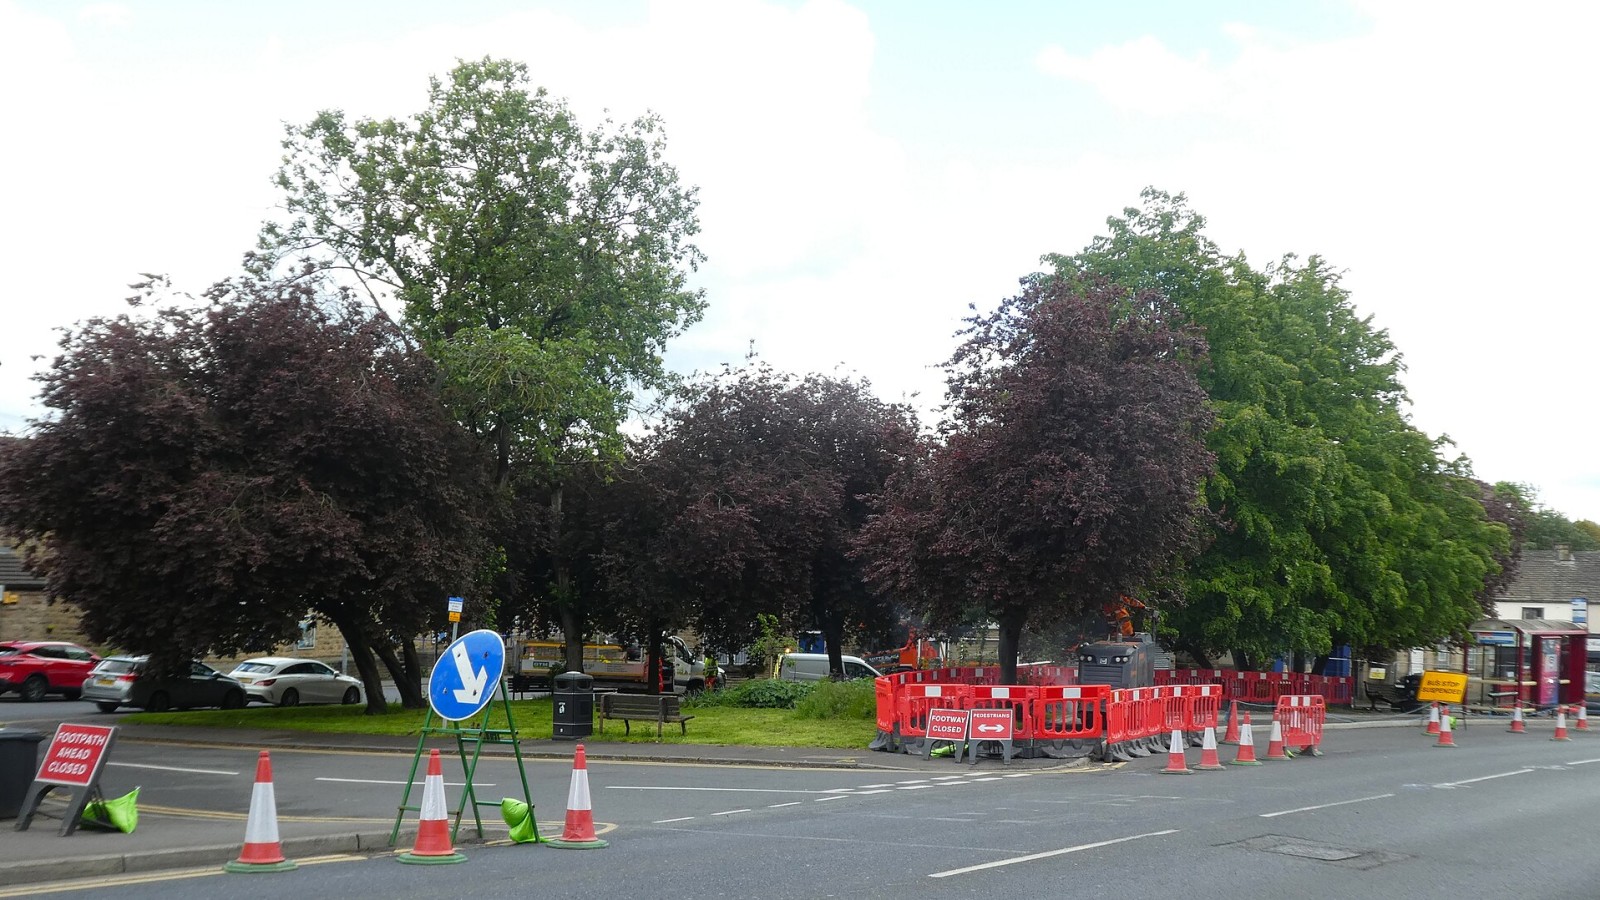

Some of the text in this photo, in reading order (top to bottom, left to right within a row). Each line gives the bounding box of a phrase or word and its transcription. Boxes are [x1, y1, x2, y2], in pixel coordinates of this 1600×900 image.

[931, 715, 966, 723] FOOTWAY
[932, 725, 962, 733] CLOSED
[55, 732, 106, 746] FOOTPATH
[56, 747, 92, 760] AHEAD
[47, 761, 88, 775] CLOSED
